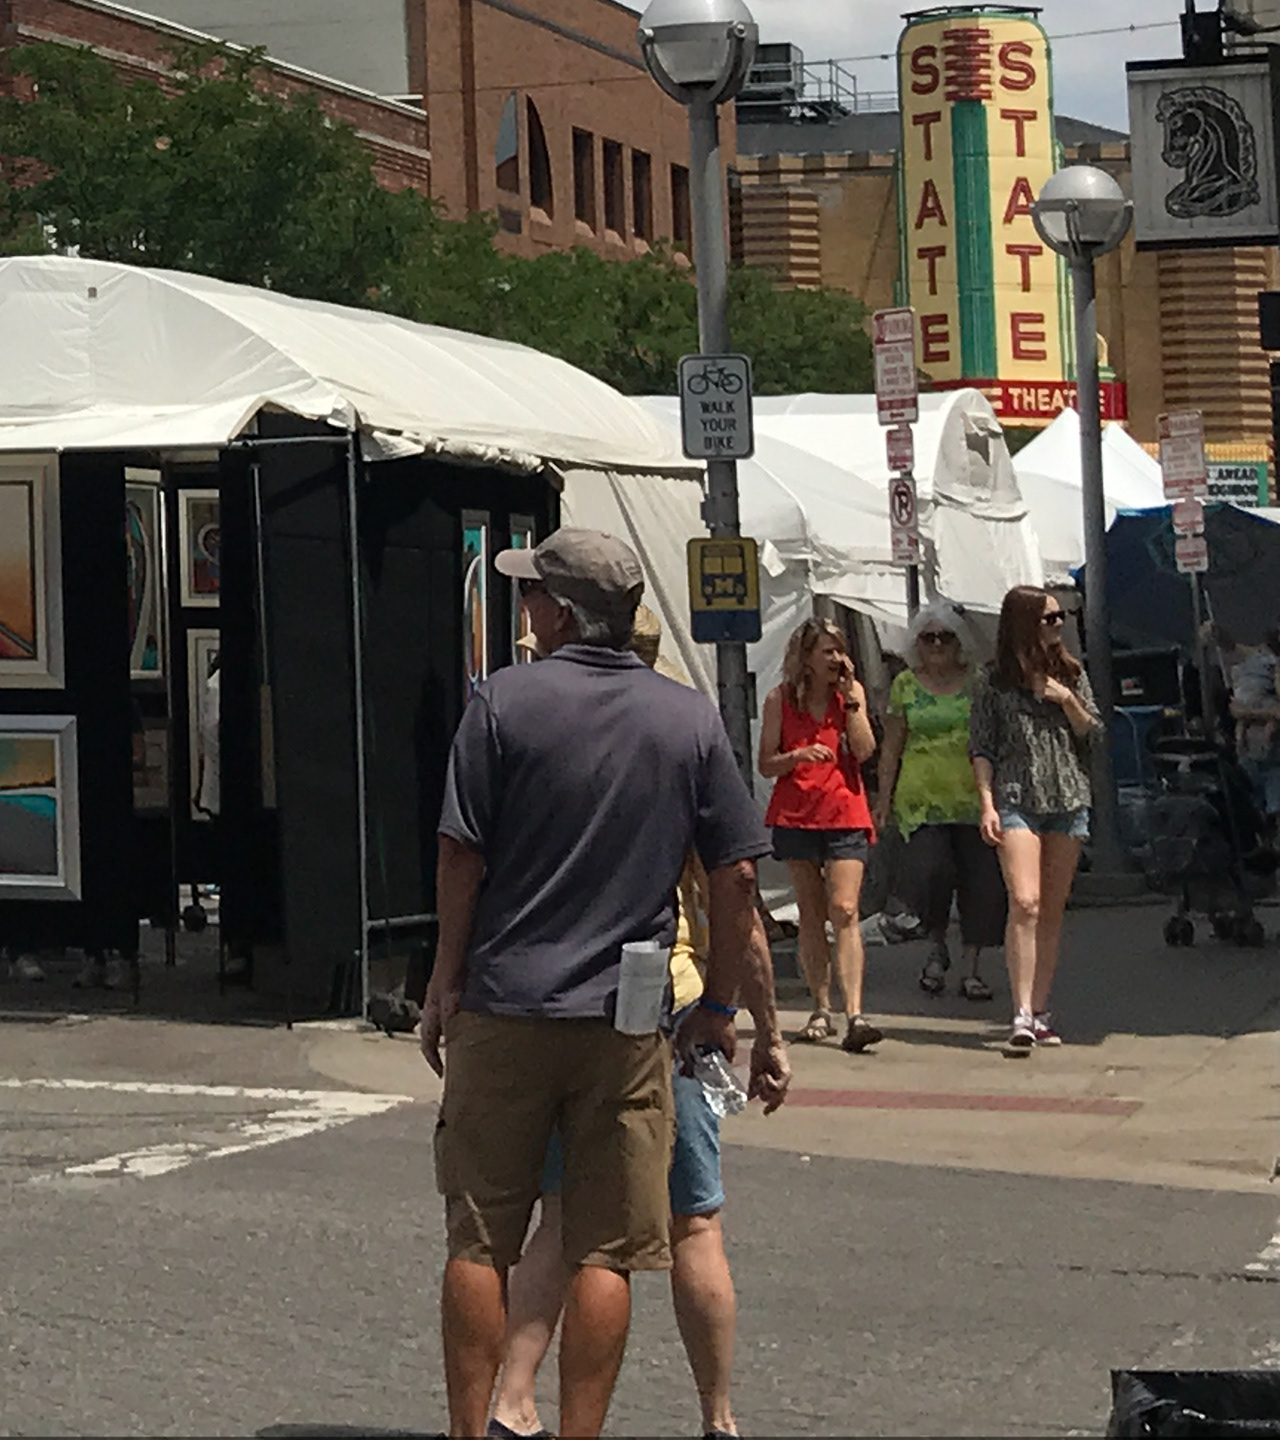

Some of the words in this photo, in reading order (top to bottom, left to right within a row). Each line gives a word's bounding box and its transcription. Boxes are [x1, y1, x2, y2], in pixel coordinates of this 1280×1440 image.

[909, 45, 950, 363] STATE
[998, 40, 1048, 361] STATE
[700, 401, 736, 414] WALK
[700, 419, 737, 432] YOUR
